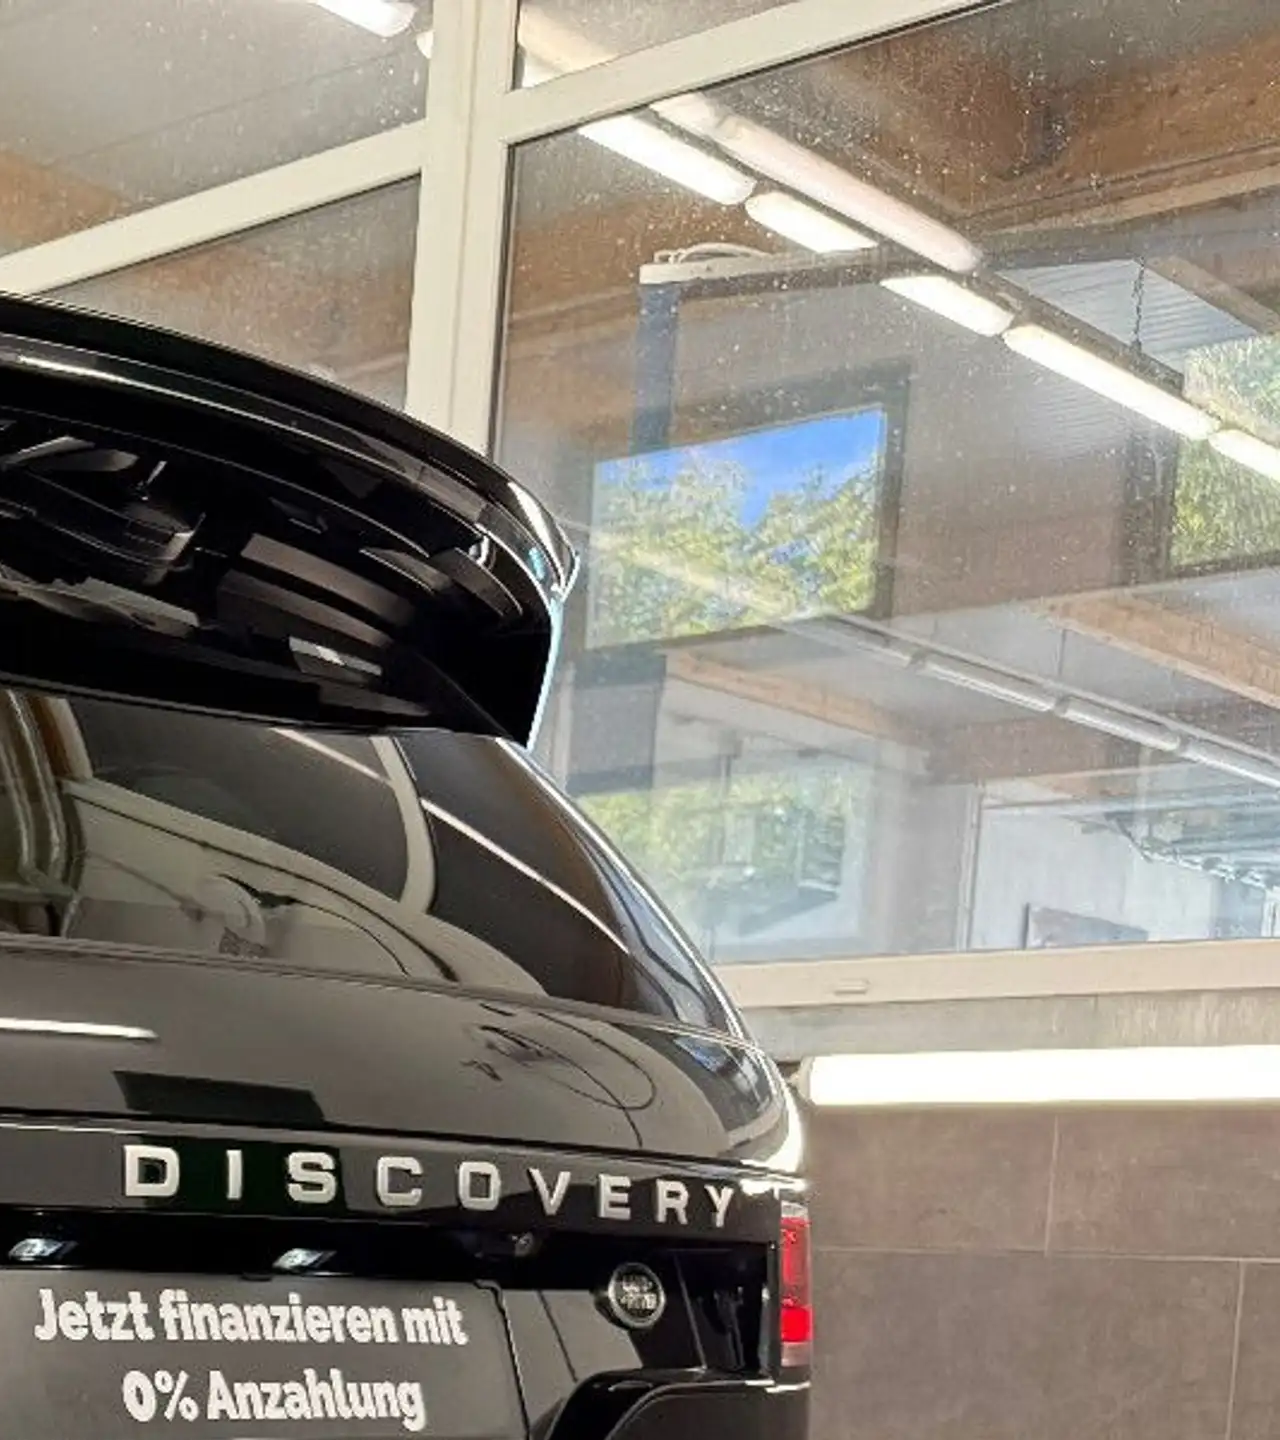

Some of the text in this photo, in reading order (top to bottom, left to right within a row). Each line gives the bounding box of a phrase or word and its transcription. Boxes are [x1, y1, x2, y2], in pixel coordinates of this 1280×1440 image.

[122, 1144, 735, 1228] DISCOVERY
[34, 1288, 469, 1345] Jetzt finanzieren mit
[122, 1367, 427, 1432] 0% Anzahlung
